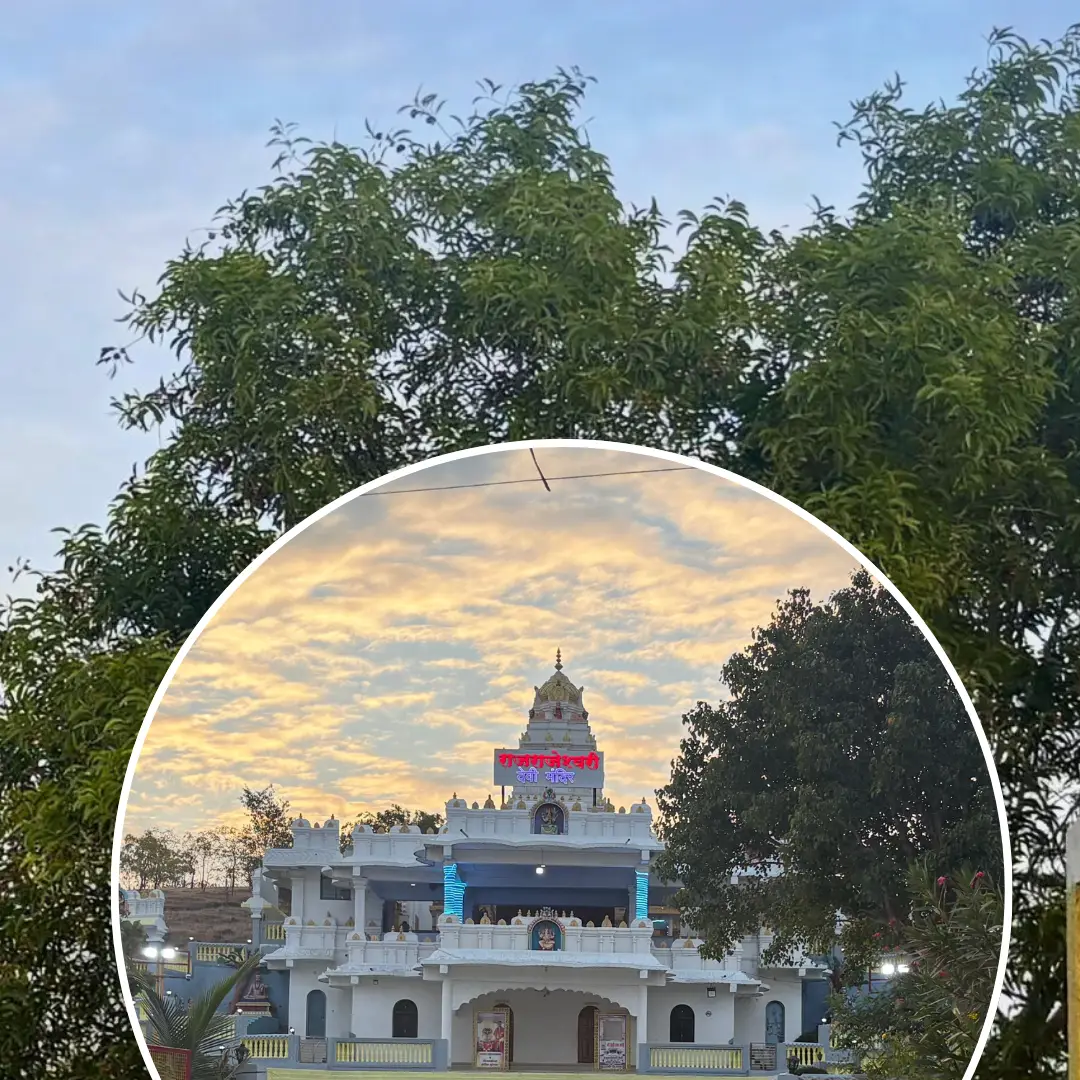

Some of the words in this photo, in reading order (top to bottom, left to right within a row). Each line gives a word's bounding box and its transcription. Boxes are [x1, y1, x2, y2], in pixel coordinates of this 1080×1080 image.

[499, 750, 600, 770] राजराजेश्वरी
[516, 767, 539, 784] देवी
[545, 767, 575, 785] मंदिर
